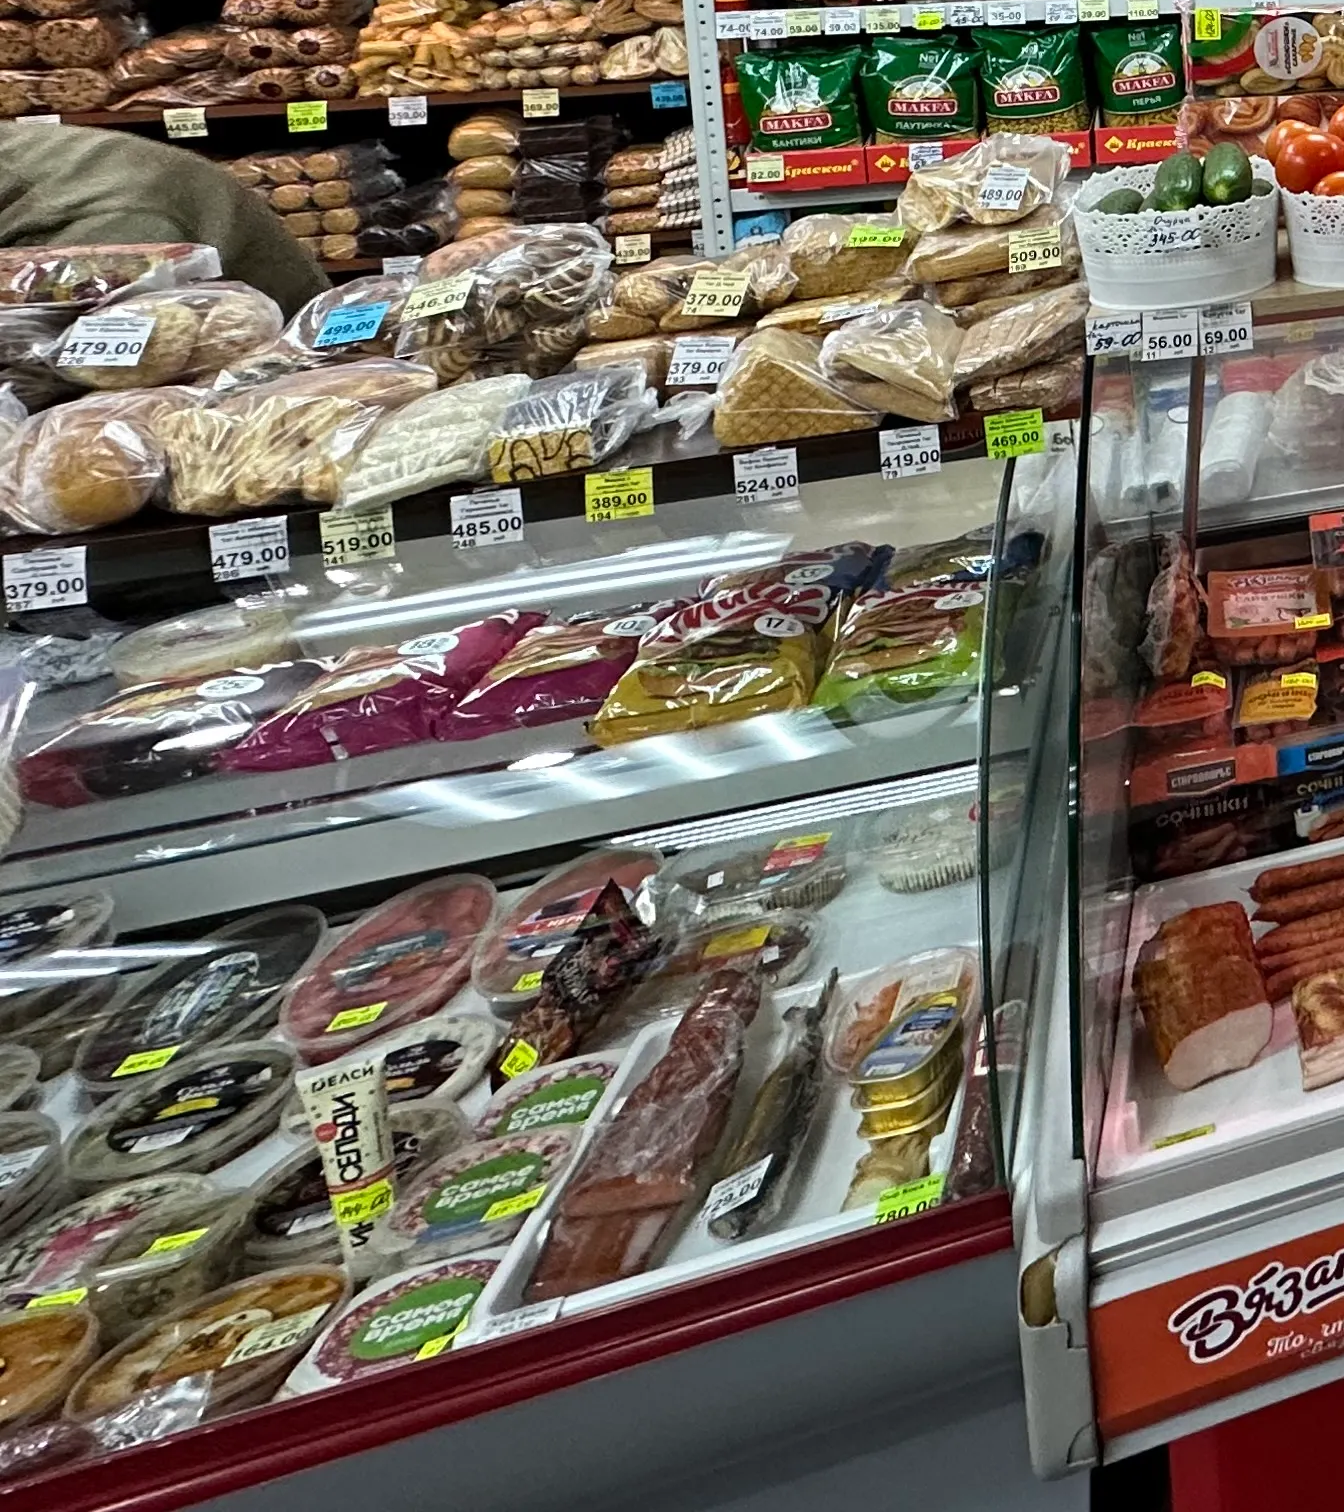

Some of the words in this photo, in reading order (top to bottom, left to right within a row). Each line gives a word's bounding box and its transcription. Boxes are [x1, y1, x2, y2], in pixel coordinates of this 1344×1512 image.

[755, 28, 783, 36] 74.00
[1118, 79, 1169, 90] MAKFA
[893, 100, 953, 113] MAKFA
[751, 171, 780, 181] 82.00
[979, 189, 1022, 200] 489.00
[1011, 247, 1060, 265] 509.00
[687, 294, 742, 306] 379.00
[323, 320, 375, 335] 499.00
[1149, 334, 1191, 349] 56.00
[1205, 328, 1247, 344] 69.00
[63, 342, 142, 356] 479.00
[992, 431, 1039, 448] 469.00
[881, 450, 940, 468] 419.00
[737, 475, 796, 496] 524.00
[452, 517, 522, 538] 485.00
[323, 532, 393, 553] 519.00
[213, 546, 287, 568] 479.00
[5, 577, 85, 600] 379.00
